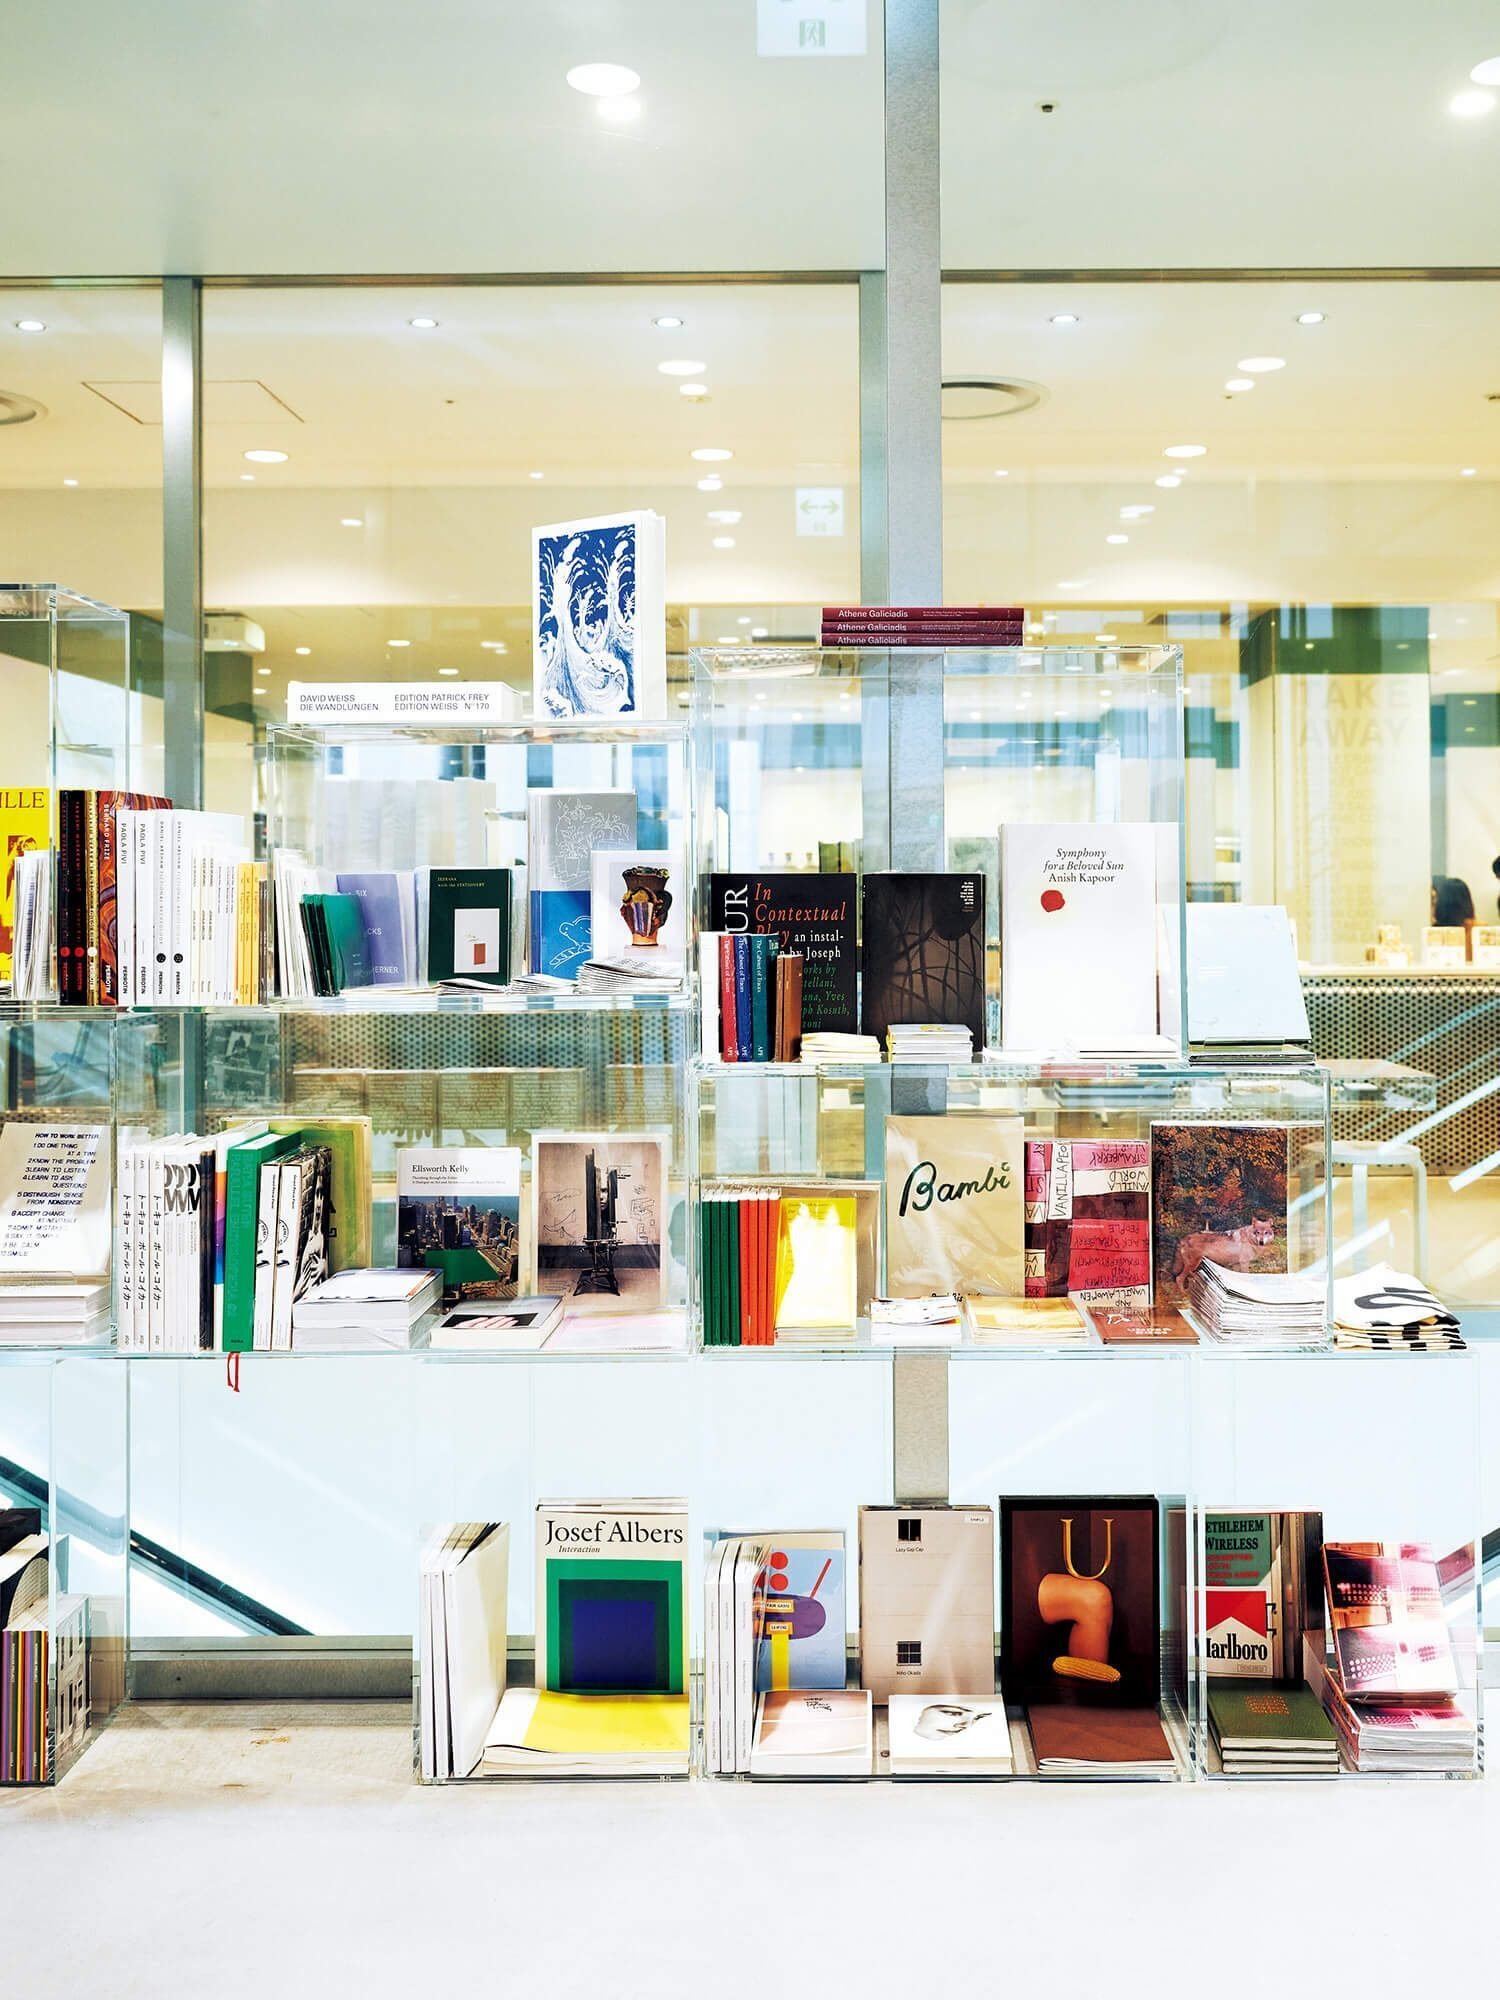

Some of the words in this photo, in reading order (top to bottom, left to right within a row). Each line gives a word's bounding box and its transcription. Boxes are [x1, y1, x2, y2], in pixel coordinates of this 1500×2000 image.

[838, 610, 867, 618] Athene
[869, 610, 908, 618] Galiciadis
[837, 623, 866, 631] Athene
[867, 623, 907, 631] Galiciadis
[837, 636, 866, 644] Athene
[300, 694, 326, 702] DAVID
[327, 694, 355, 702] WEISS
[468, 693, 489, 701] FREY
[300, 703, 313, 711] DIE
[315, 703, 379, 711] WANDLUNGEN
[394, 702, 429, 710] EDITION
[431, 702, 458, 710] WEISS
[1056, 847, 1107, 860] Symphony
[1043, 860, 1058, 873] for
[1067, 860, 1105, 870] Beloved
[1106, 861, 1124, 870] Sun
[1049, 872, 1077, 882] Anish
[1079, 873, 1115, 885] Kapoor
[754, 882, 772, 901] In
[755, 901, 846, 921] Contextual
[756, 924, 790, 947] Ply
[794, 933, 806, 942] an
[810, 930, 844, 942] instal-
[806, 946, 841, 961] Joseph
[802, 964, 822, 974] orks
[825, 962, 837, 977] by
[825, 991, 845, 1001] Yves
[1089, 1151, 1146, 1166] STRAWBERRY
[412, 1164, 447, 1172] Ellsworth
[449, 1164, 469, 1174] Kelly
[1052, 1142, 1070, 1217] VANILLAPEO
[1109, 1170, 1147, 1182] WORLD
[899, 1161, 1010, 1217] Bambi
[545, 1520, 606, 1545] Josef
[607, 1521, 683, 1543] Albers
[1206, 1519, 1264, 1533] ETHLEHEM
[558, 1545, 601, 1553] Interaction
[1060, 1518, 1114, 1580] U
[1206, 1537, 1259, 1550] WIRELESS
